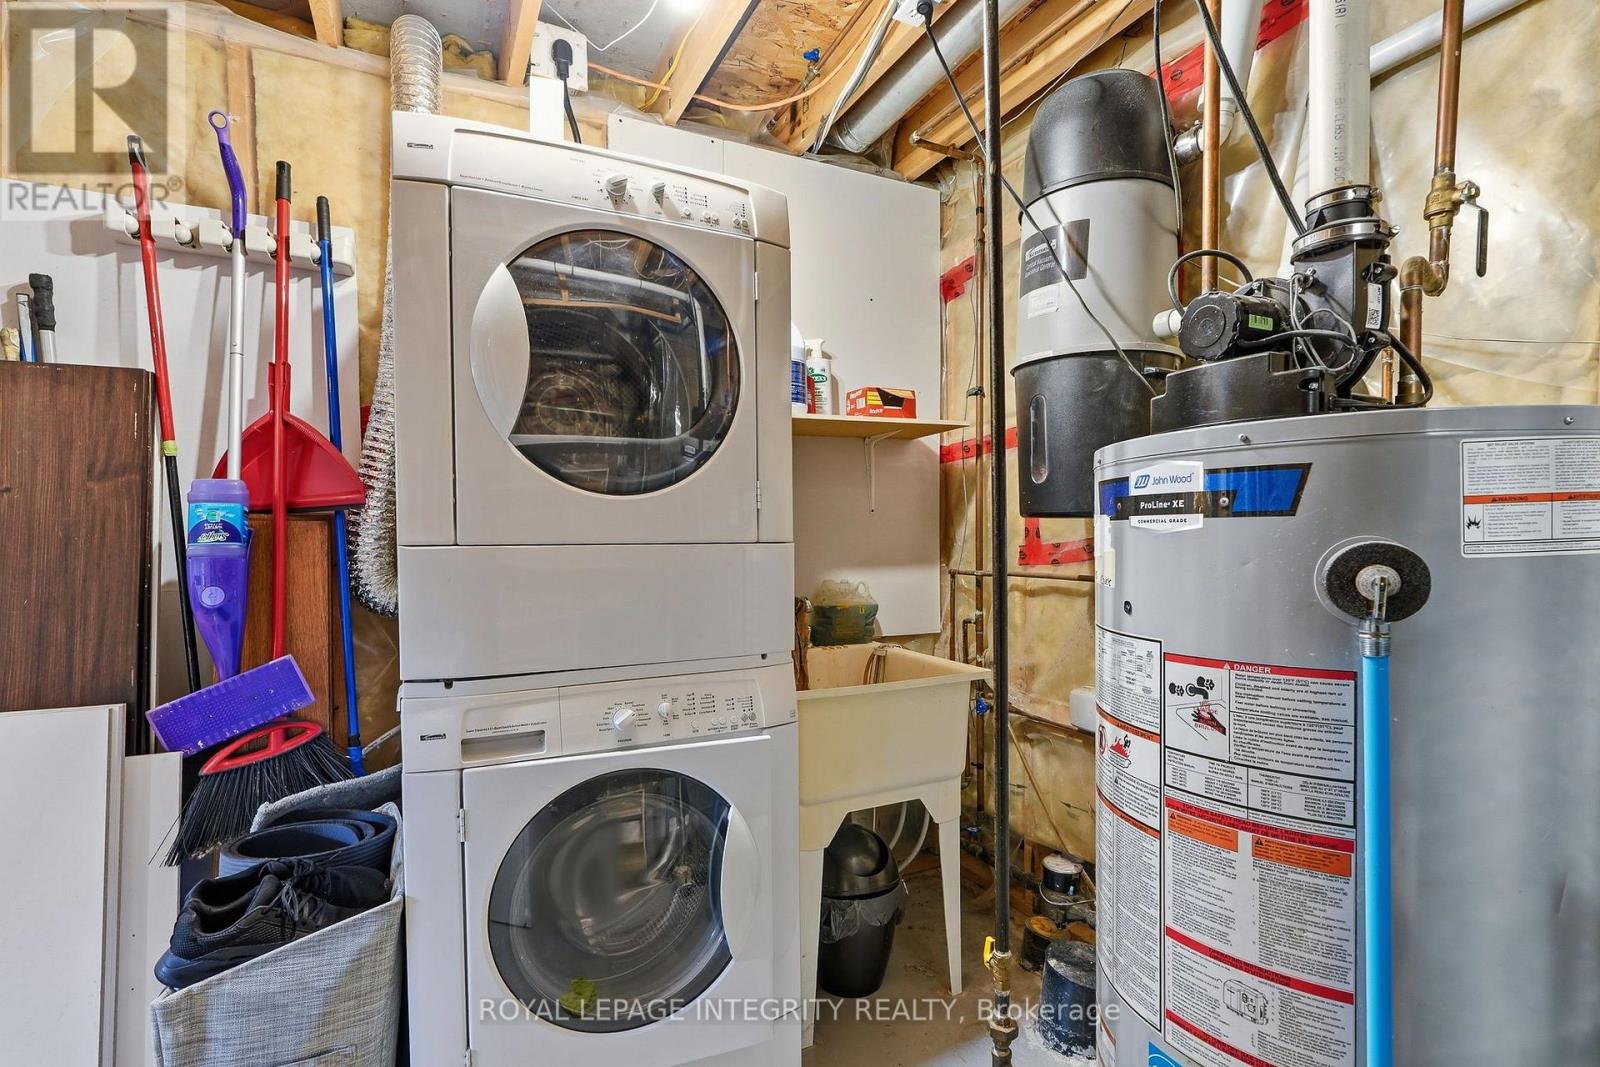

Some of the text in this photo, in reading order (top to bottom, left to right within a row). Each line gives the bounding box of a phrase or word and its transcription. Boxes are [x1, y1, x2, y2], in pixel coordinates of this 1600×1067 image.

[1152, 474, 1192, 485] John Wood
[1172, 500, 1185, 508] XE
[1234, 664, 1271, 674] DANGER
